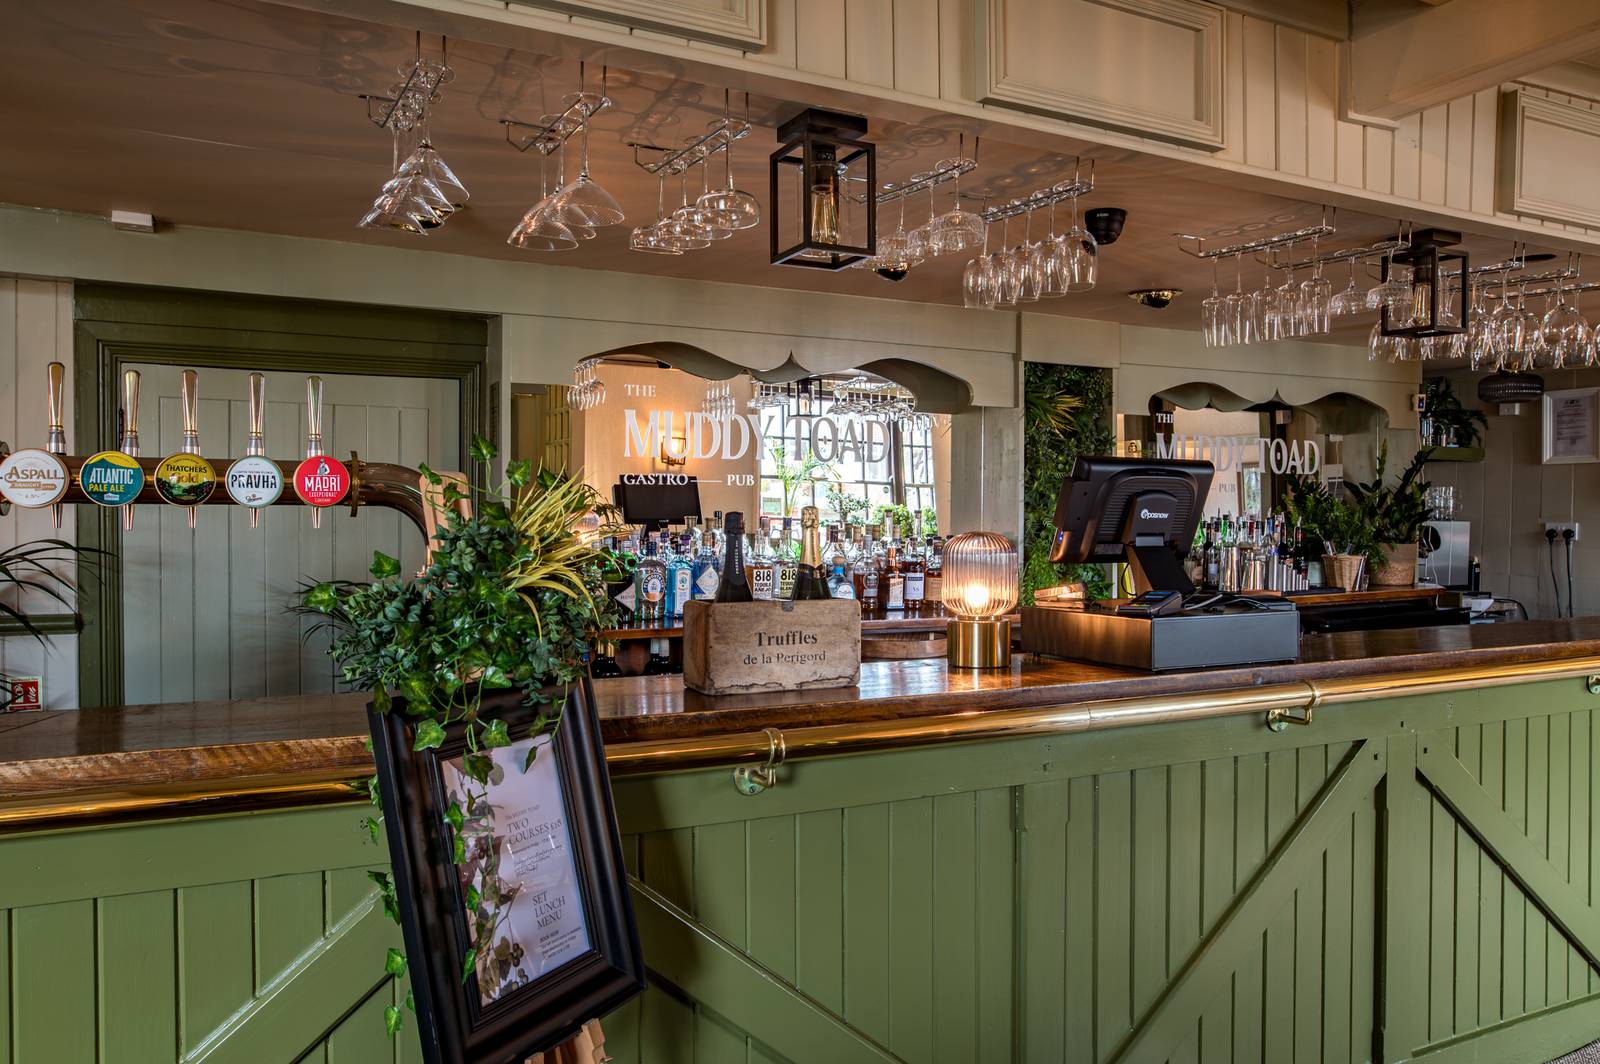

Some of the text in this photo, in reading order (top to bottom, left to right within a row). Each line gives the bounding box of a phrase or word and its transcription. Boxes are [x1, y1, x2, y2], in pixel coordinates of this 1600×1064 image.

[624, 384, 657, 397] THE
[624, 409, 891, 464] MUDDY TOAD
[1255, 438, 1320, 475] TOAD
[4, 466, 61, 481] ASPALL
[89, 467, 134, 484] ATLANTIC
[166, 463, 208, 474] THATCHERS
[231, 474, 277, 489] PRAVHA
[623, 473, 754, 486] GASTRO PUB
[88, 483, 125, 493] PALE ALE
[755, 570, 772, 582] 818
[754, 630, 818, 647] Truffles
[743, 653, 758, 665] de
[762, 653, 772, 664] la
[506, 817, 529, 833] TWO
[508, 822, 550, 845] COURSES
[532, 890, 547, 906] SET
[535, 895, 566, 918] LUNCH
[537, 909, 562, 930] MENU
